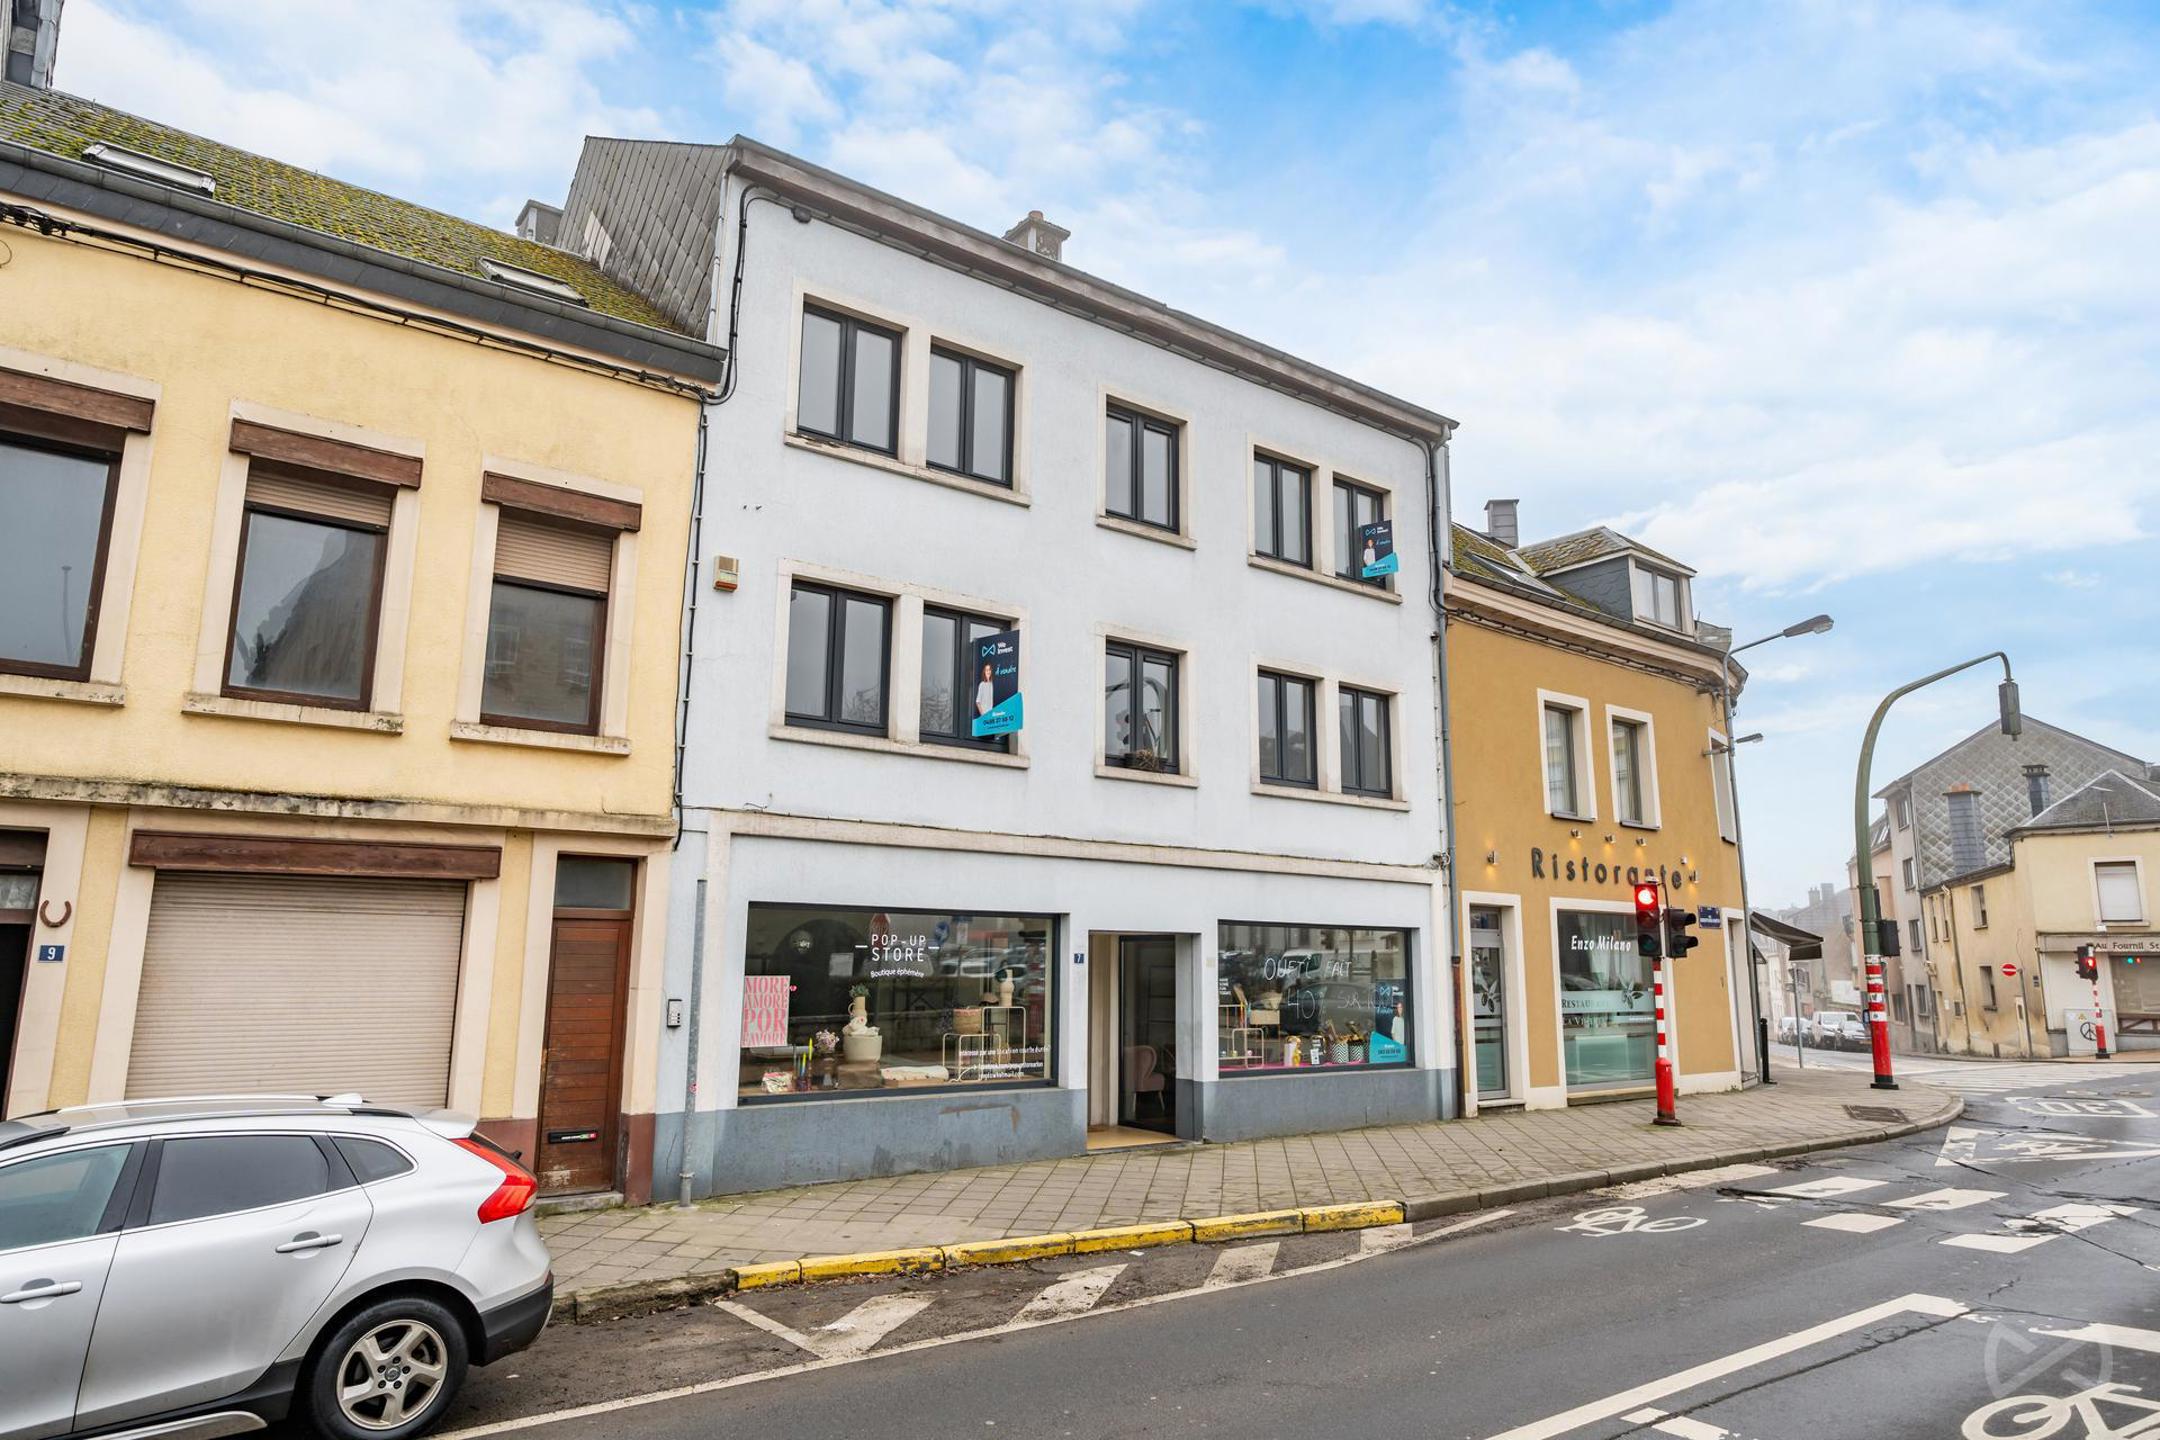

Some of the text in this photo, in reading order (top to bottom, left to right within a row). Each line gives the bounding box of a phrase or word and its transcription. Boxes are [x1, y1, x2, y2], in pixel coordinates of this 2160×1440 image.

[871, 934, 926, 946] POP-UP
[1571, 935, 1632, 951] Enzo Milano
[47, 947, 56, 960] 9
[871, 947, 924, 962] STORE
[870, 968, 896, 979] Boutique
[745, 977, 789, 993] MORE
[743, 1008, 787, 1033] POR
